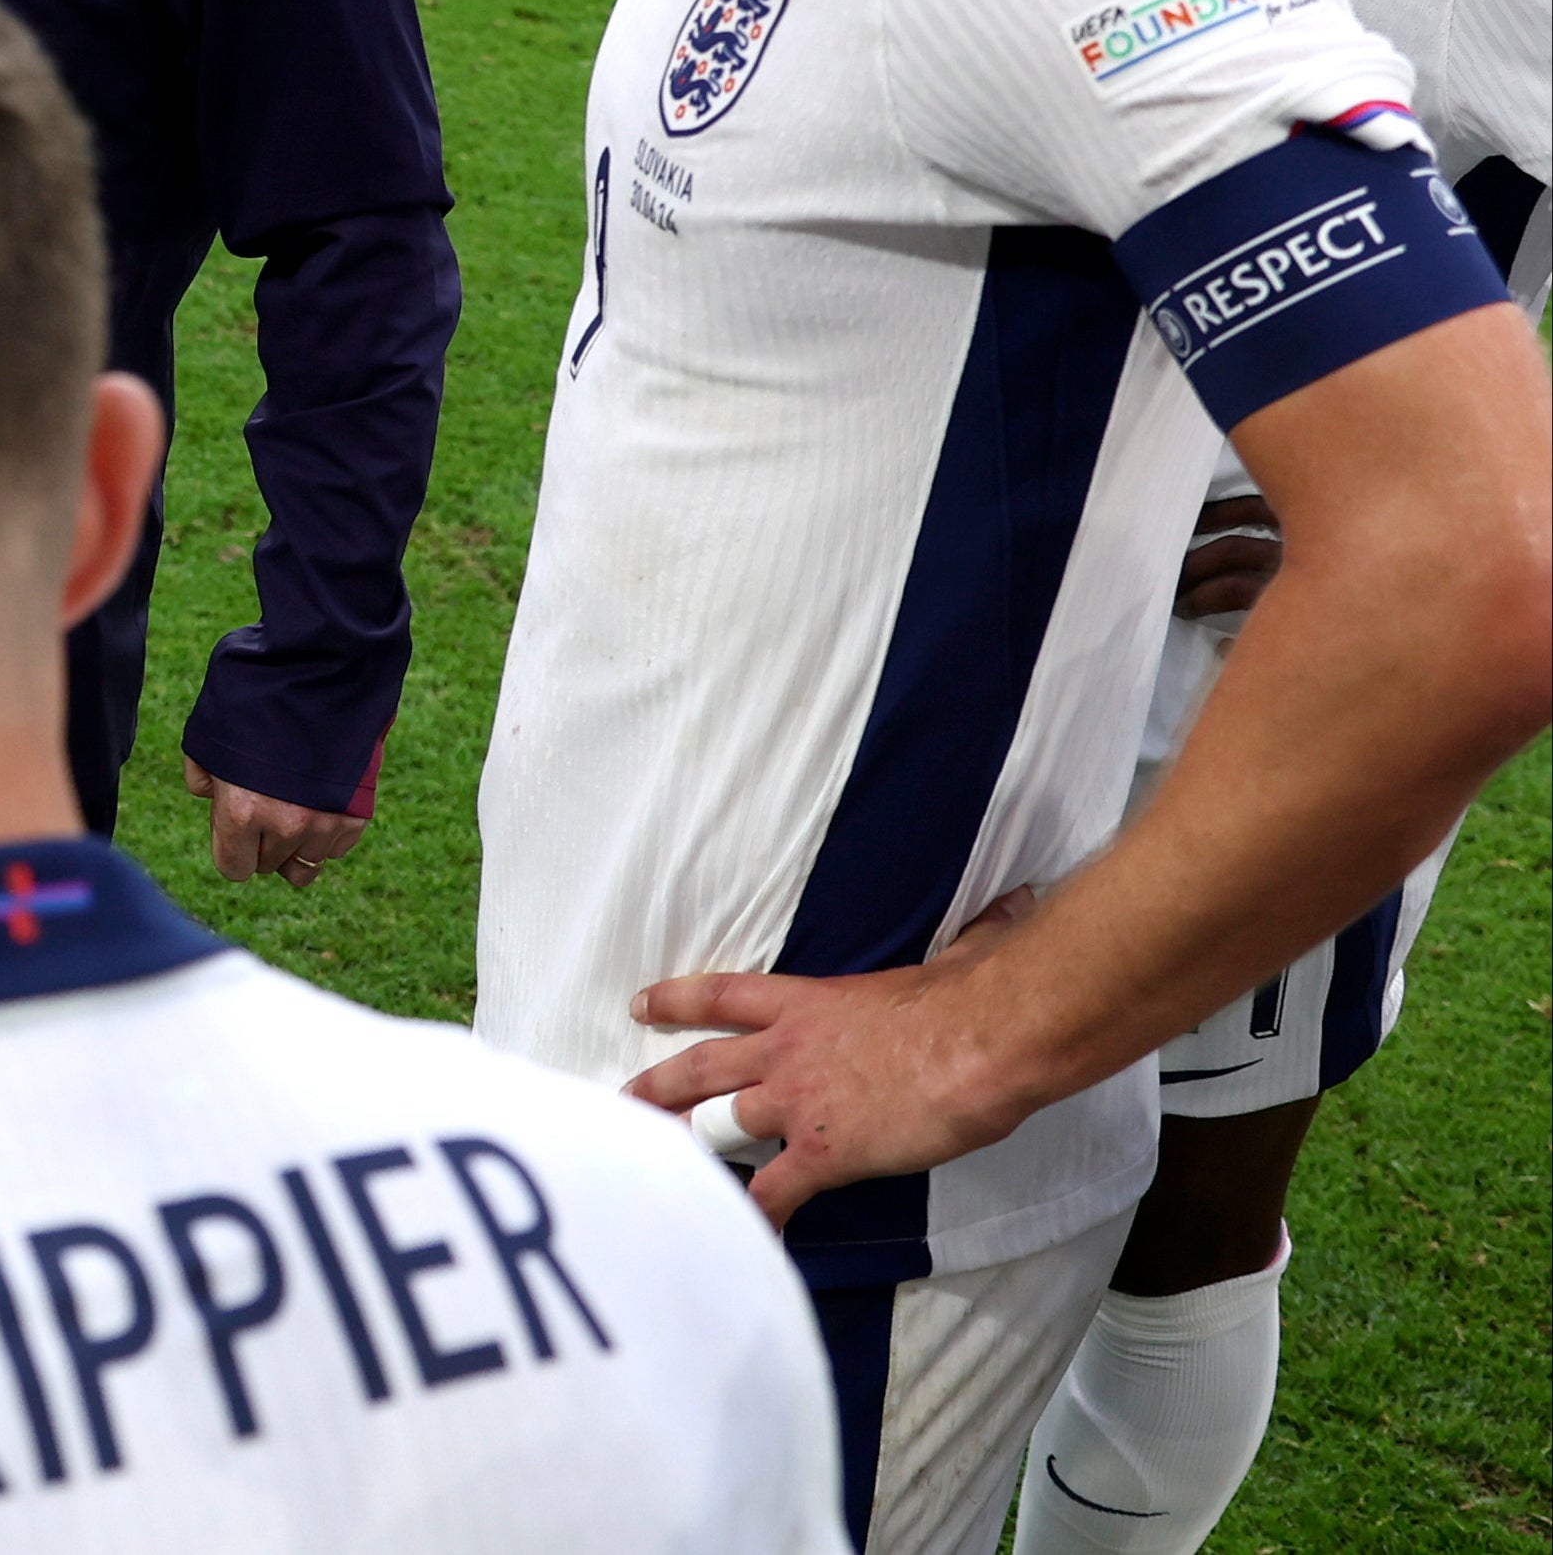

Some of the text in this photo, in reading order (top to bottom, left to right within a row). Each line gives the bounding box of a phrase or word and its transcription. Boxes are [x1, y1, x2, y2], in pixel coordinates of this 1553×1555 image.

[1071, 6, 1127, 45] UEFA
[634, 137, 693, 204] SLOVAKIA
[1182, 202, 1386, 334] RESPECT
